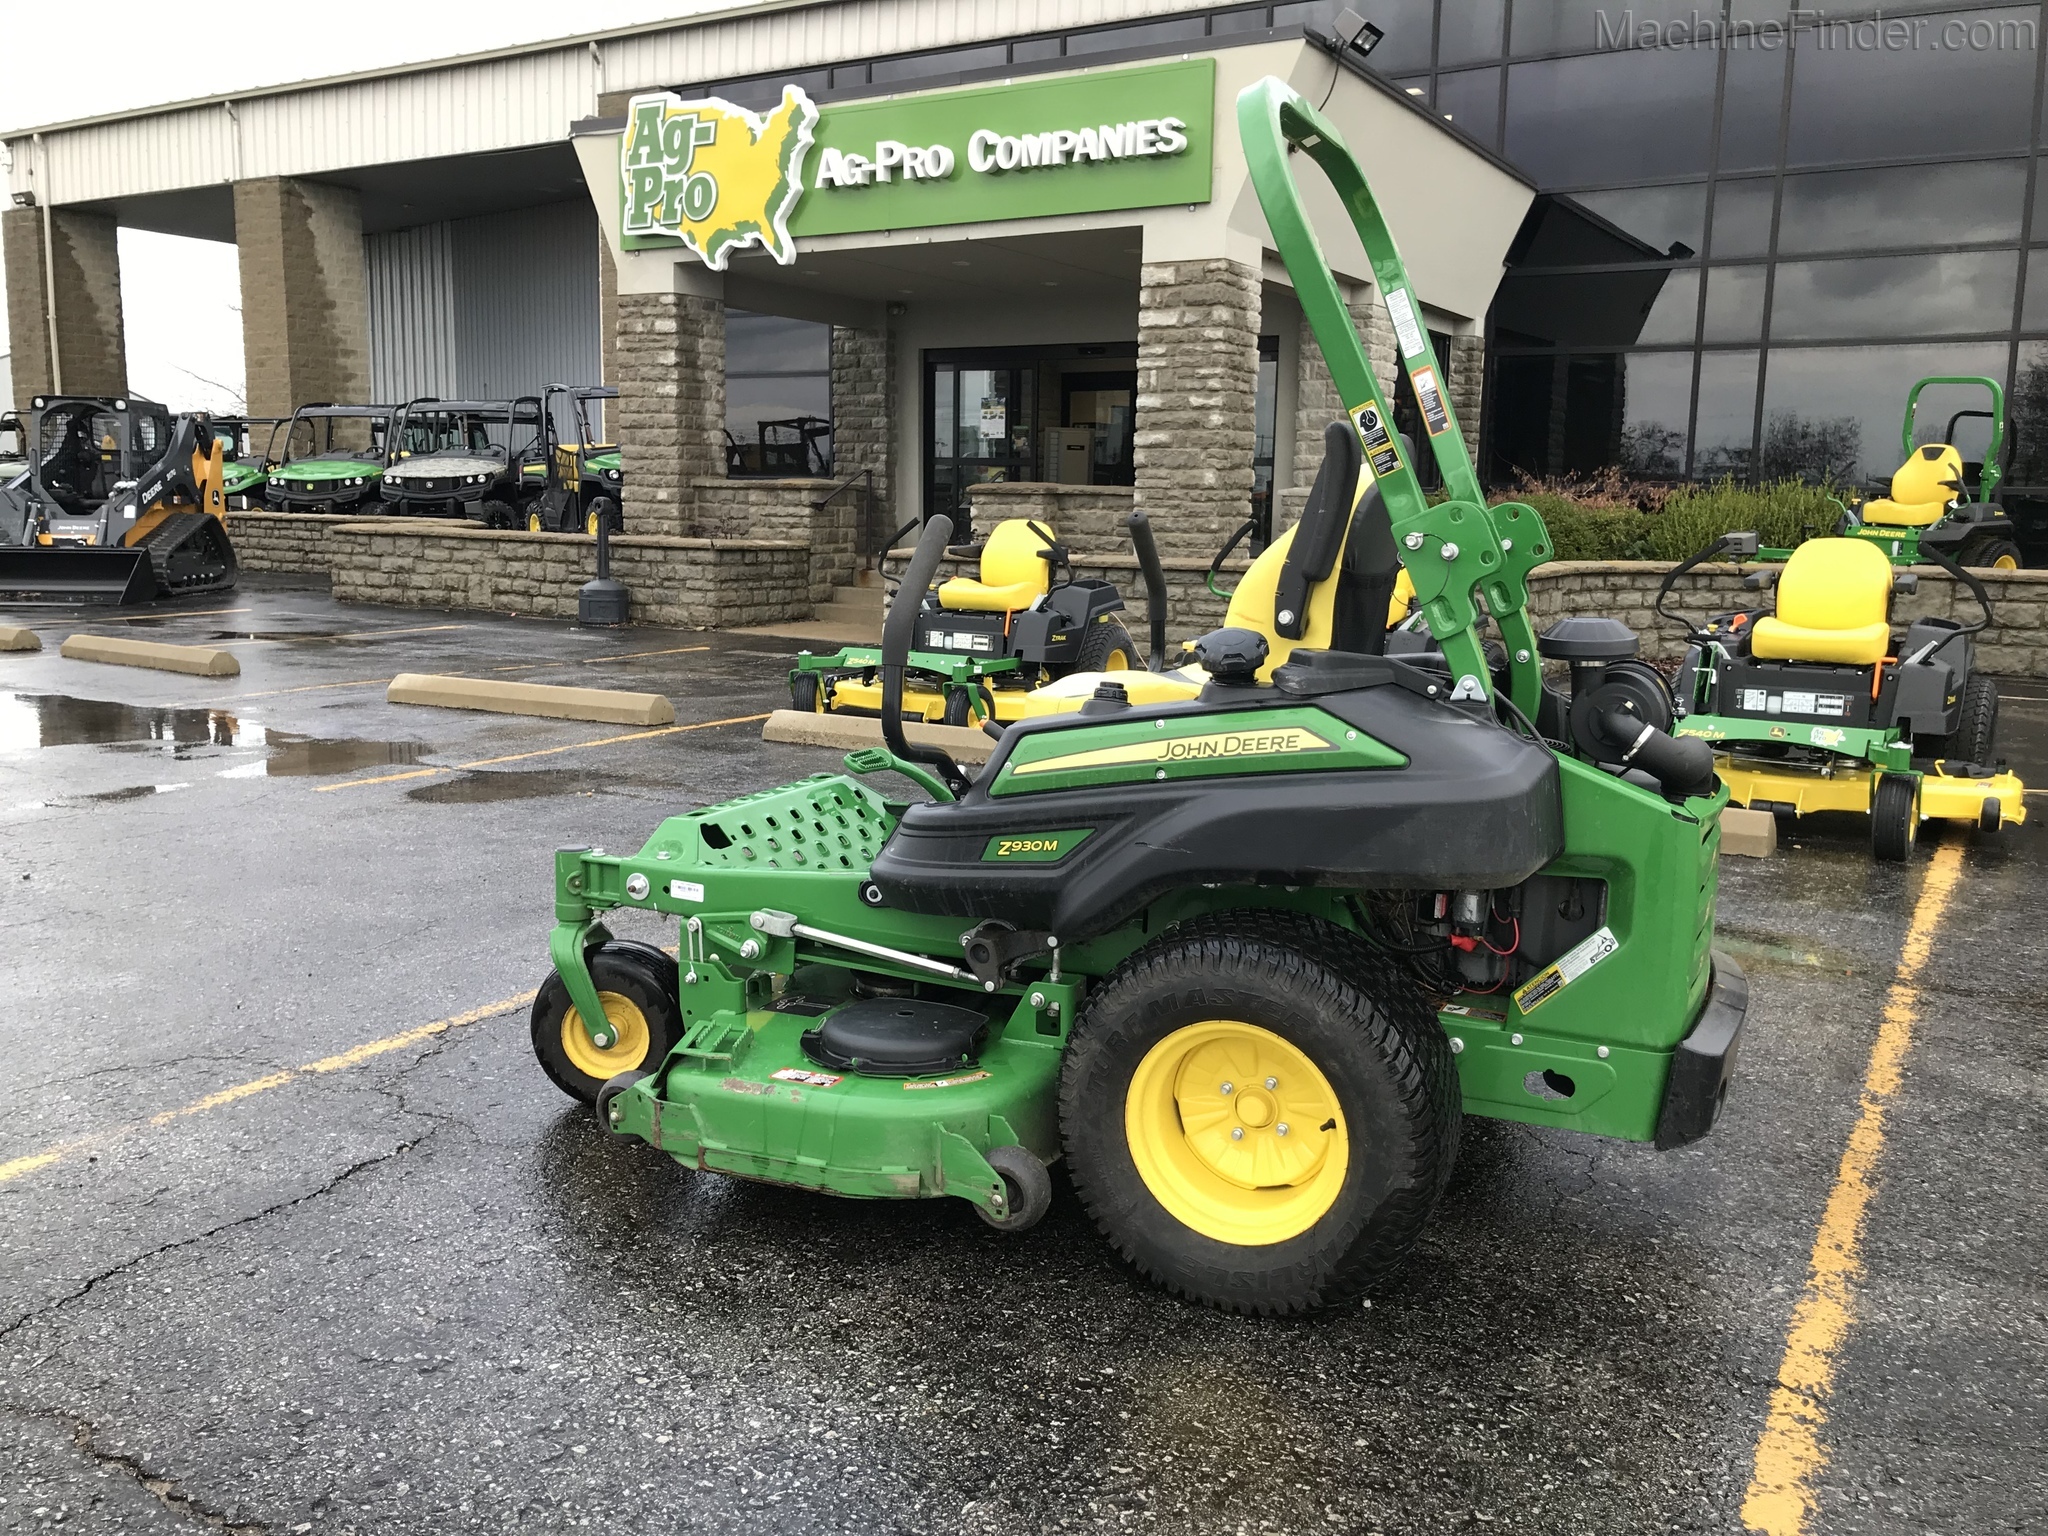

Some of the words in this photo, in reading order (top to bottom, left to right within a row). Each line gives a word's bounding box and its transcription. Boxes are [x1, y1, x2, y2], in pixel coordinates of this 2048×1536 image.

[626, 100, 718, 176] Ag-
[626, 165, 719, 229] Pro
[142, 480, 163, 504] DEERE
[1857, 528, 1879, 536] JOHN
[1879, 529, 1907, 538] DEERE
[1158, 741, 1218, 760] JOHN
[1223, 735, 1300, 753] DEERE
[1086, 1012, 1139, 1095] TURF
[1148, 988, 1312, 1036] MASTER
